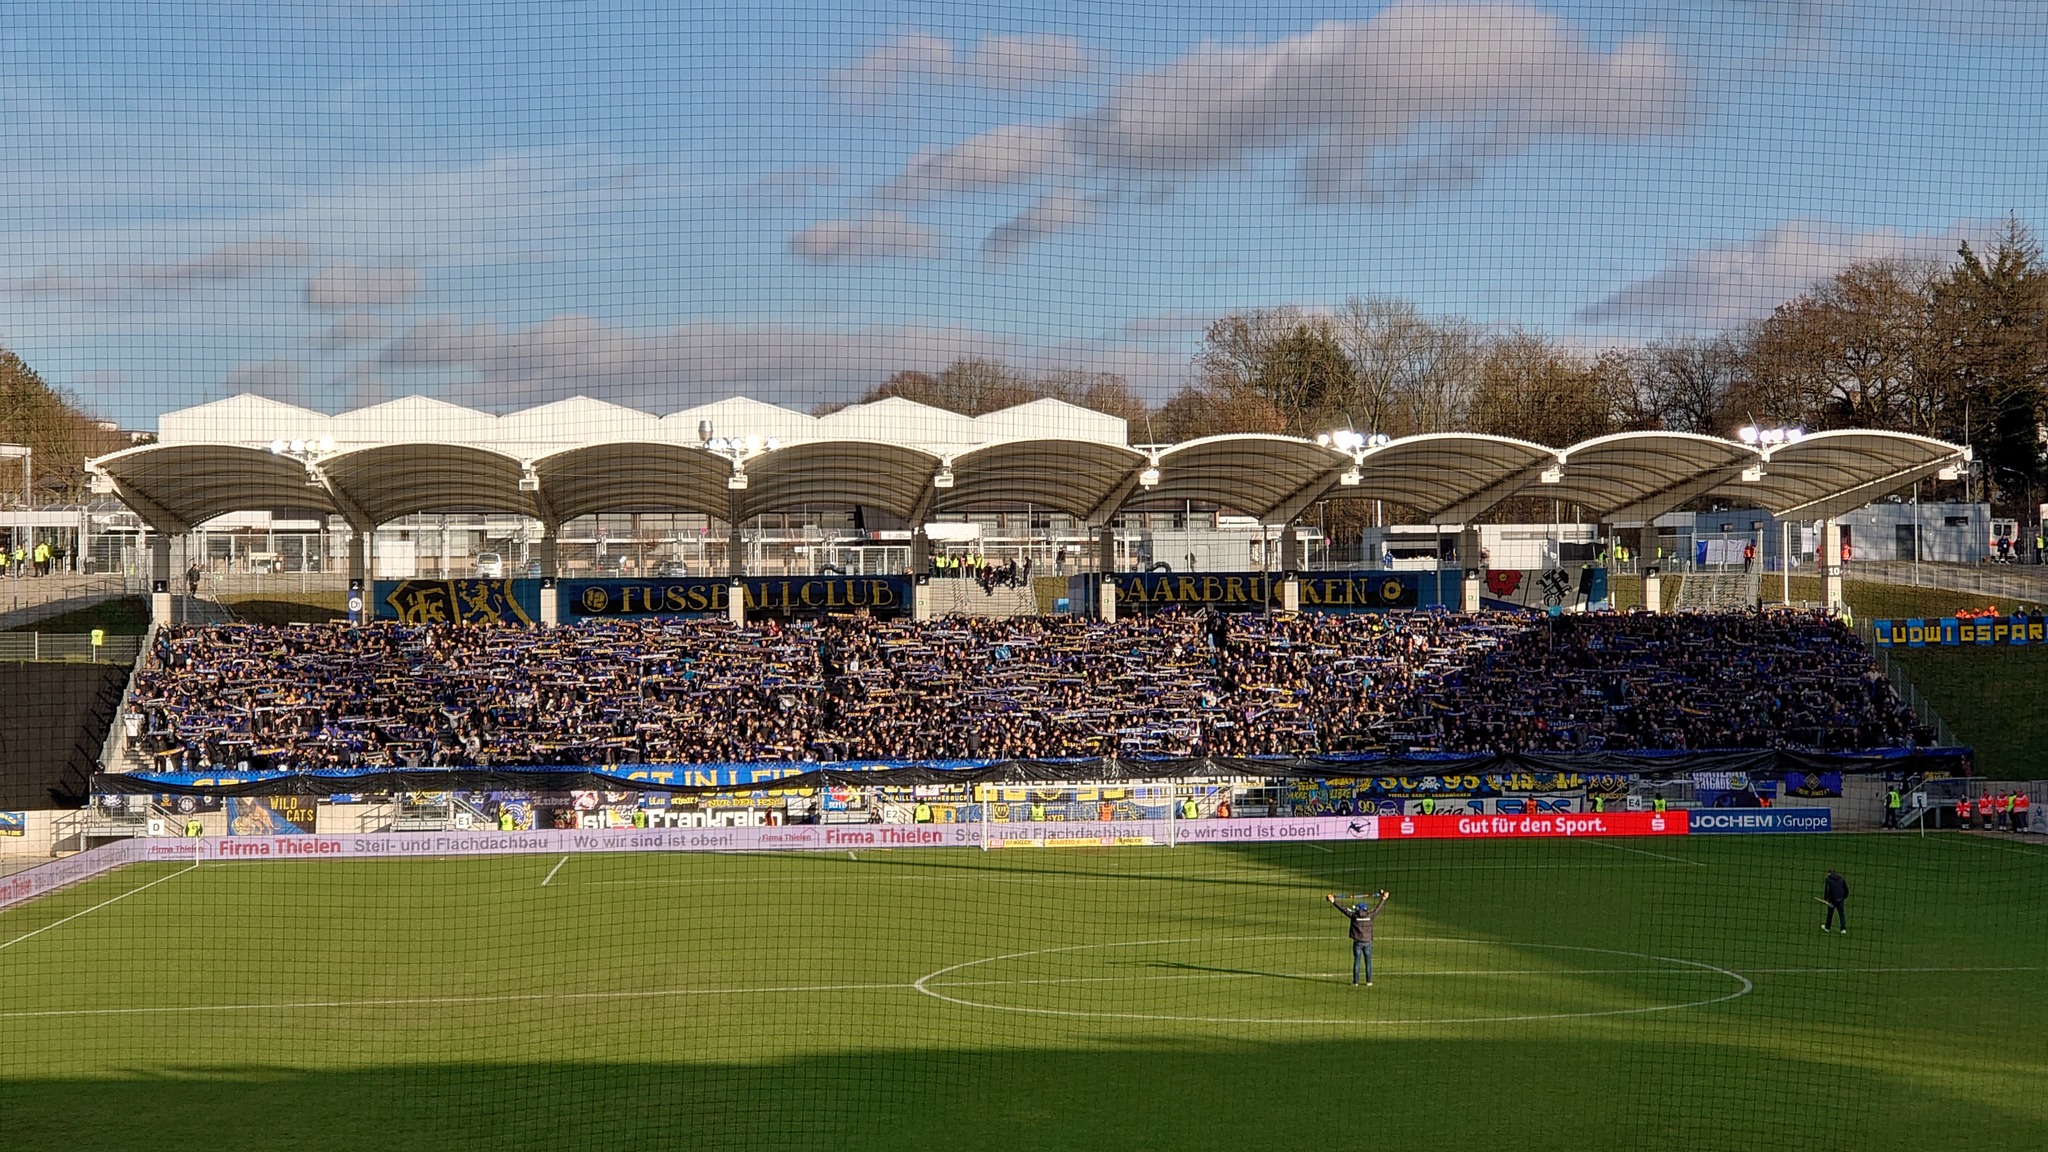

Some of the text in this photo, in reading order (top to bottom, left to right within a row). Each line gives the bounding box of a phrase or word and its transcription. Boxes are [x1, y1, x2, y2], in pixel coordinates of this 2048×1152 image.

[1828, 567, 1840, 576] 10
[919, 575, 926, 585] 5
[1104, 573, 1112, 582] 6
[1287, 572, 1294, 581] 7
[352, 581, 359, 590] 2
[544, 579, 551, 588] 3
[732, 577, 739, 586] 4
[157, 583, 163, 591] 1
[1875, 623, 2048, 643] LUDWIGSPAR
[270, 797, 298, 810] WILD
[732, 798, 755, 807] DER
[1628, 798, 1641, 807] E4
[286, 809, 314, 822] CATS
[648, 806, 783, 829] Frankreich
[886, 810, 898, 819] E2
[457, 816, 471, 826] E1
[1689, 814, 1828, 830] JOCHEM Gruppe
[152, 823, 160, 832] D
[1458, 816, 1607, 836] Gut für den Sport.
[826, 827, 943, 844] Firma Thielen
[1194, 825, 1217, 838] wir
[1221, 825, 1252, 838] sind
[1257, 824, 1274, 837] ist
[1279, 824, 1320, 837] oben!
[574, 833, 733, 848] Wo wir sind ist oben!
[784, 833, 812, 842] Thielen
[220, 838, 342, 856] Firma Thielen
[354, 835, 548, 852] Steil- und Flachdachbau
[151, 845, 173, 854] Firma
